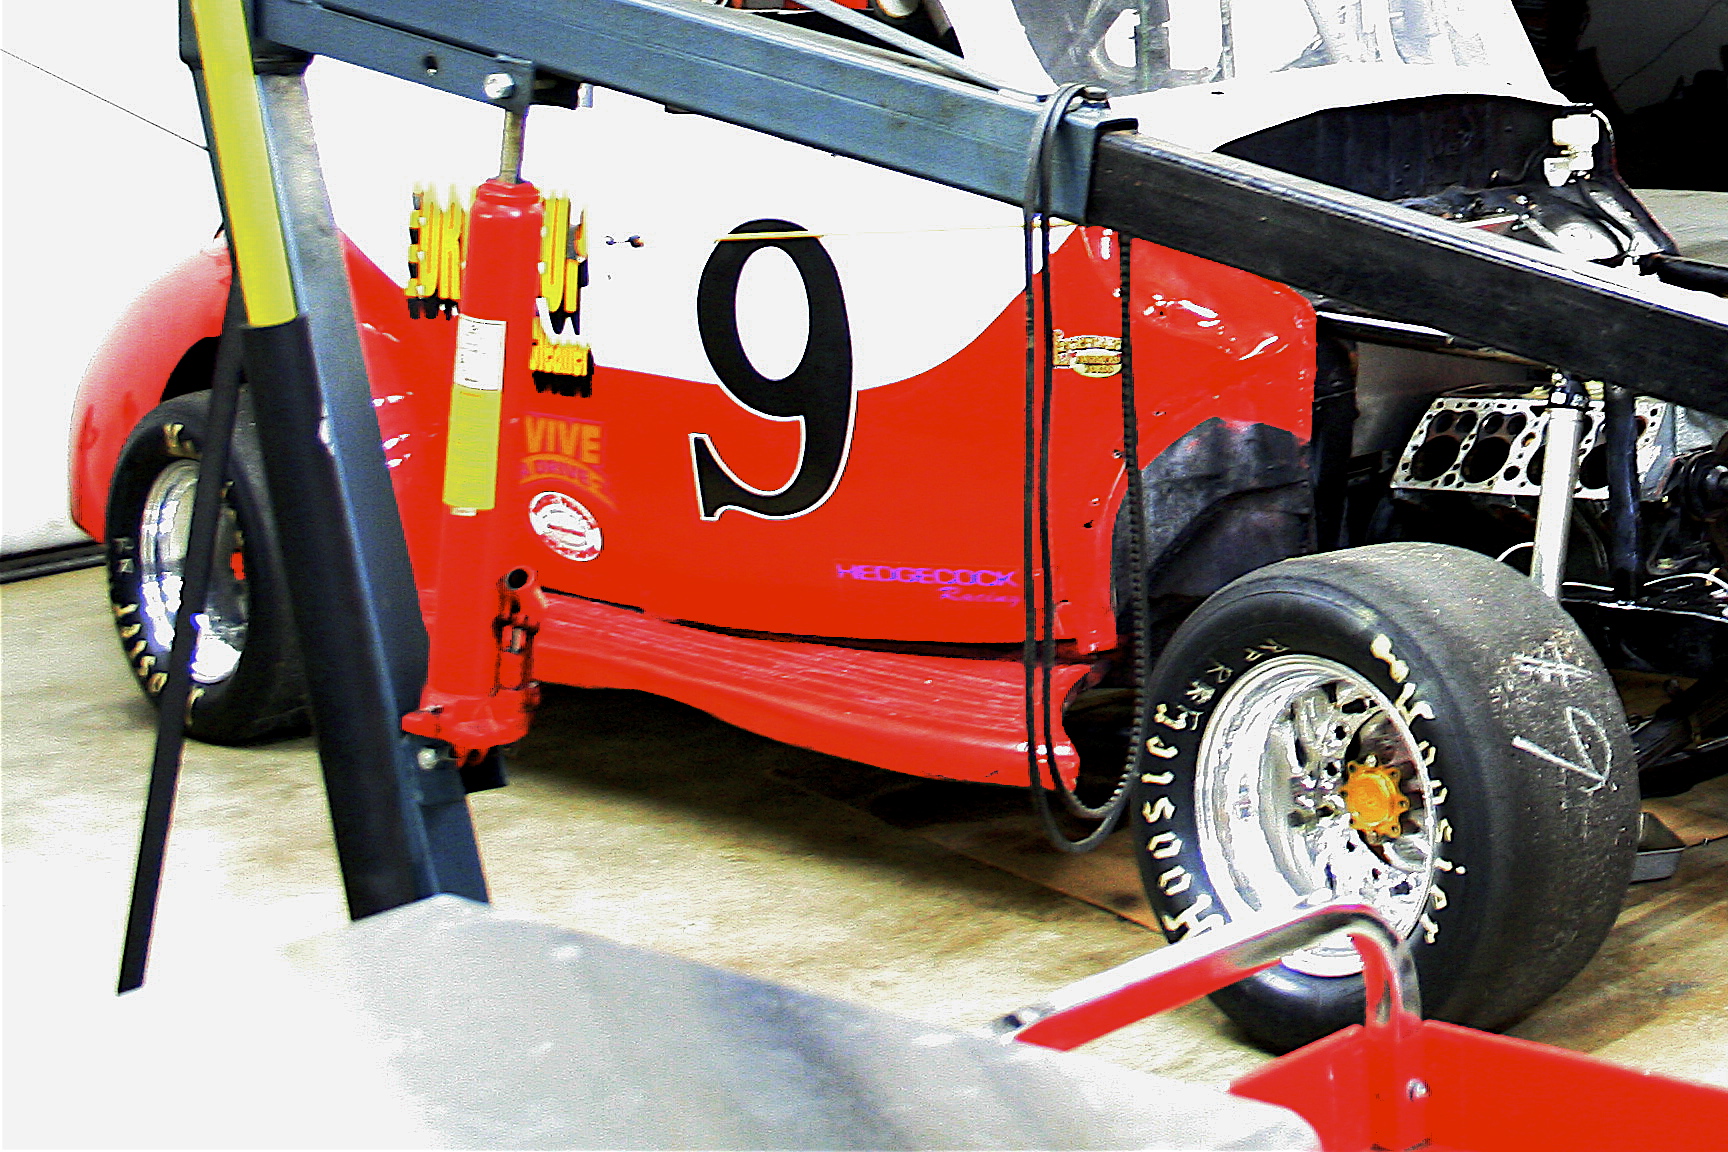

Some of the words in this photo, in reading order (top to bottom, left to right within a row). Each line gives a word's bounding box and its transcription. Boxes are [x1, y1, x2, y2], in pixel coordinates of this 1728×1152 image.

[688, 218, 858, 521] 9
[524, 414, 602, 465] VIVE
[835, 562, 1020, 588] HEDGECOCK
